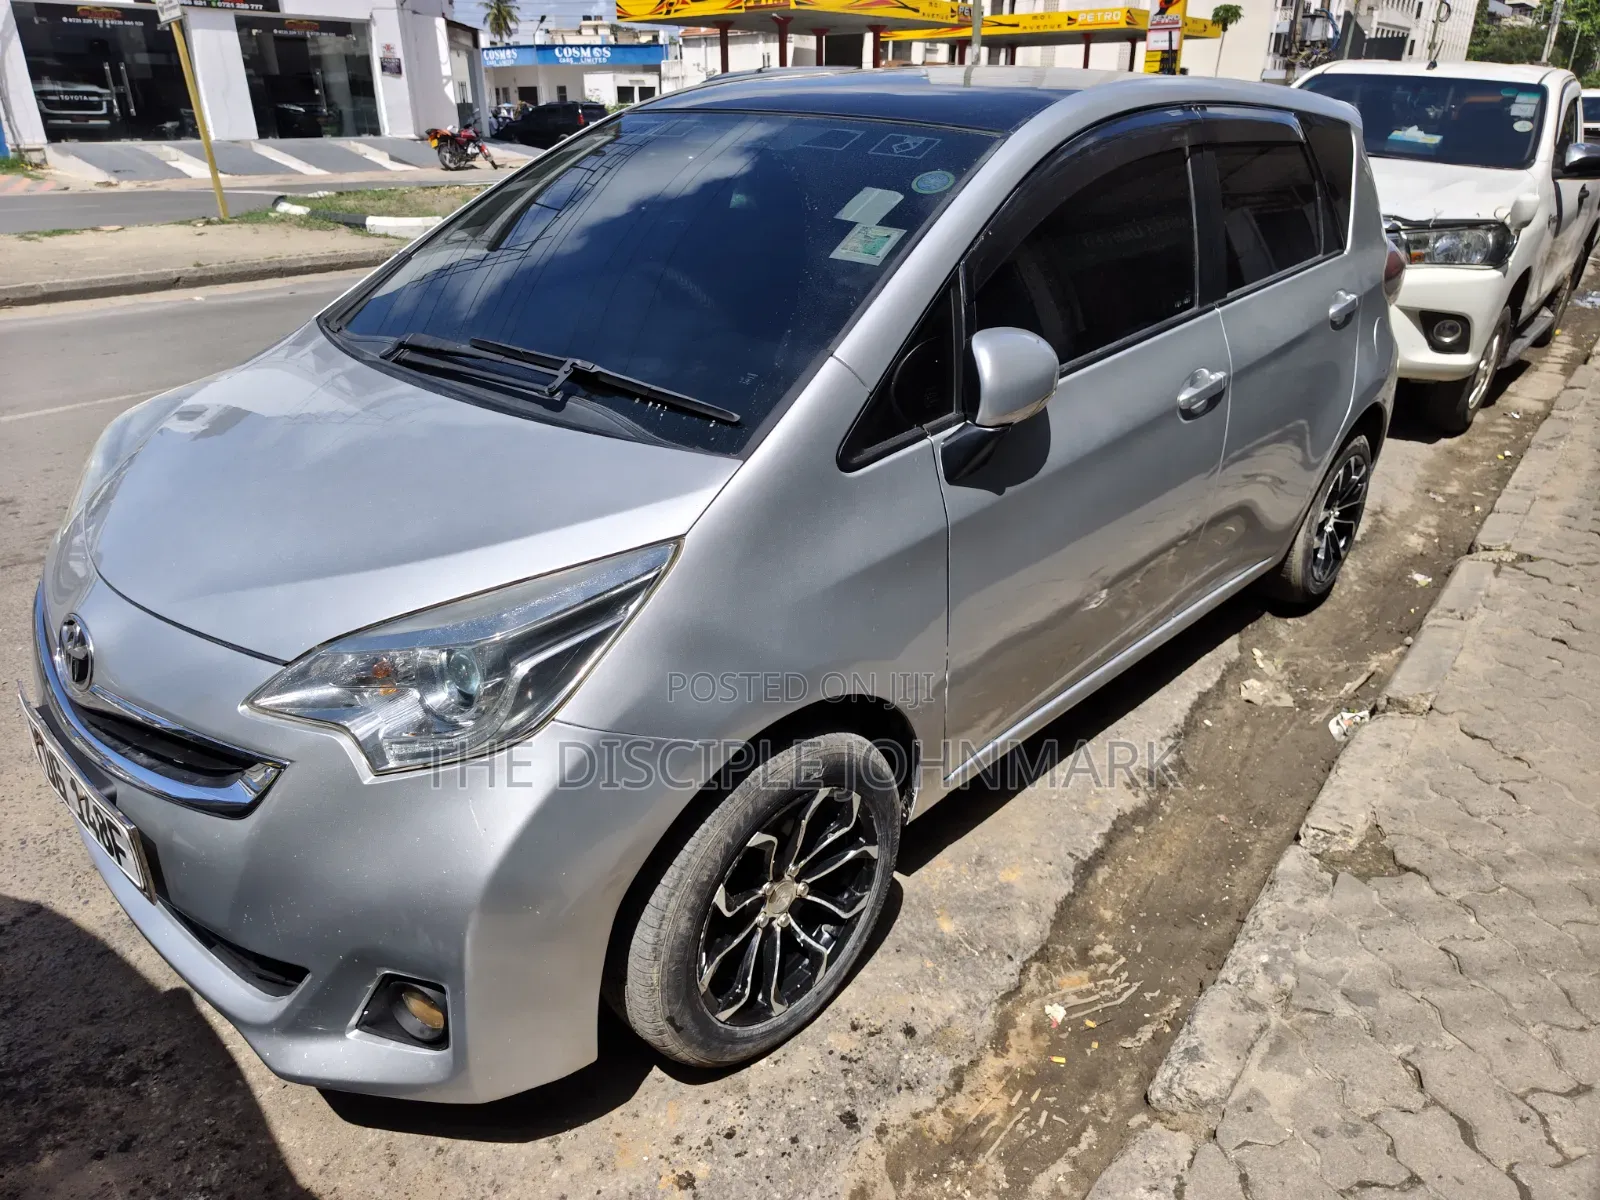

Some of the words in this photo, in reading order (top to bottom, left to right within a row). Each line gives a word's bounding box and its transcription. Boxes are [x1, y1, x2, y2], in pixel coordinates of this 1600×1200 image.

[1078, 11, 1122, 23] PETRO
[482, 48, 518, 61] COSMOS
[554, 46, 612, 59] COSMOS
